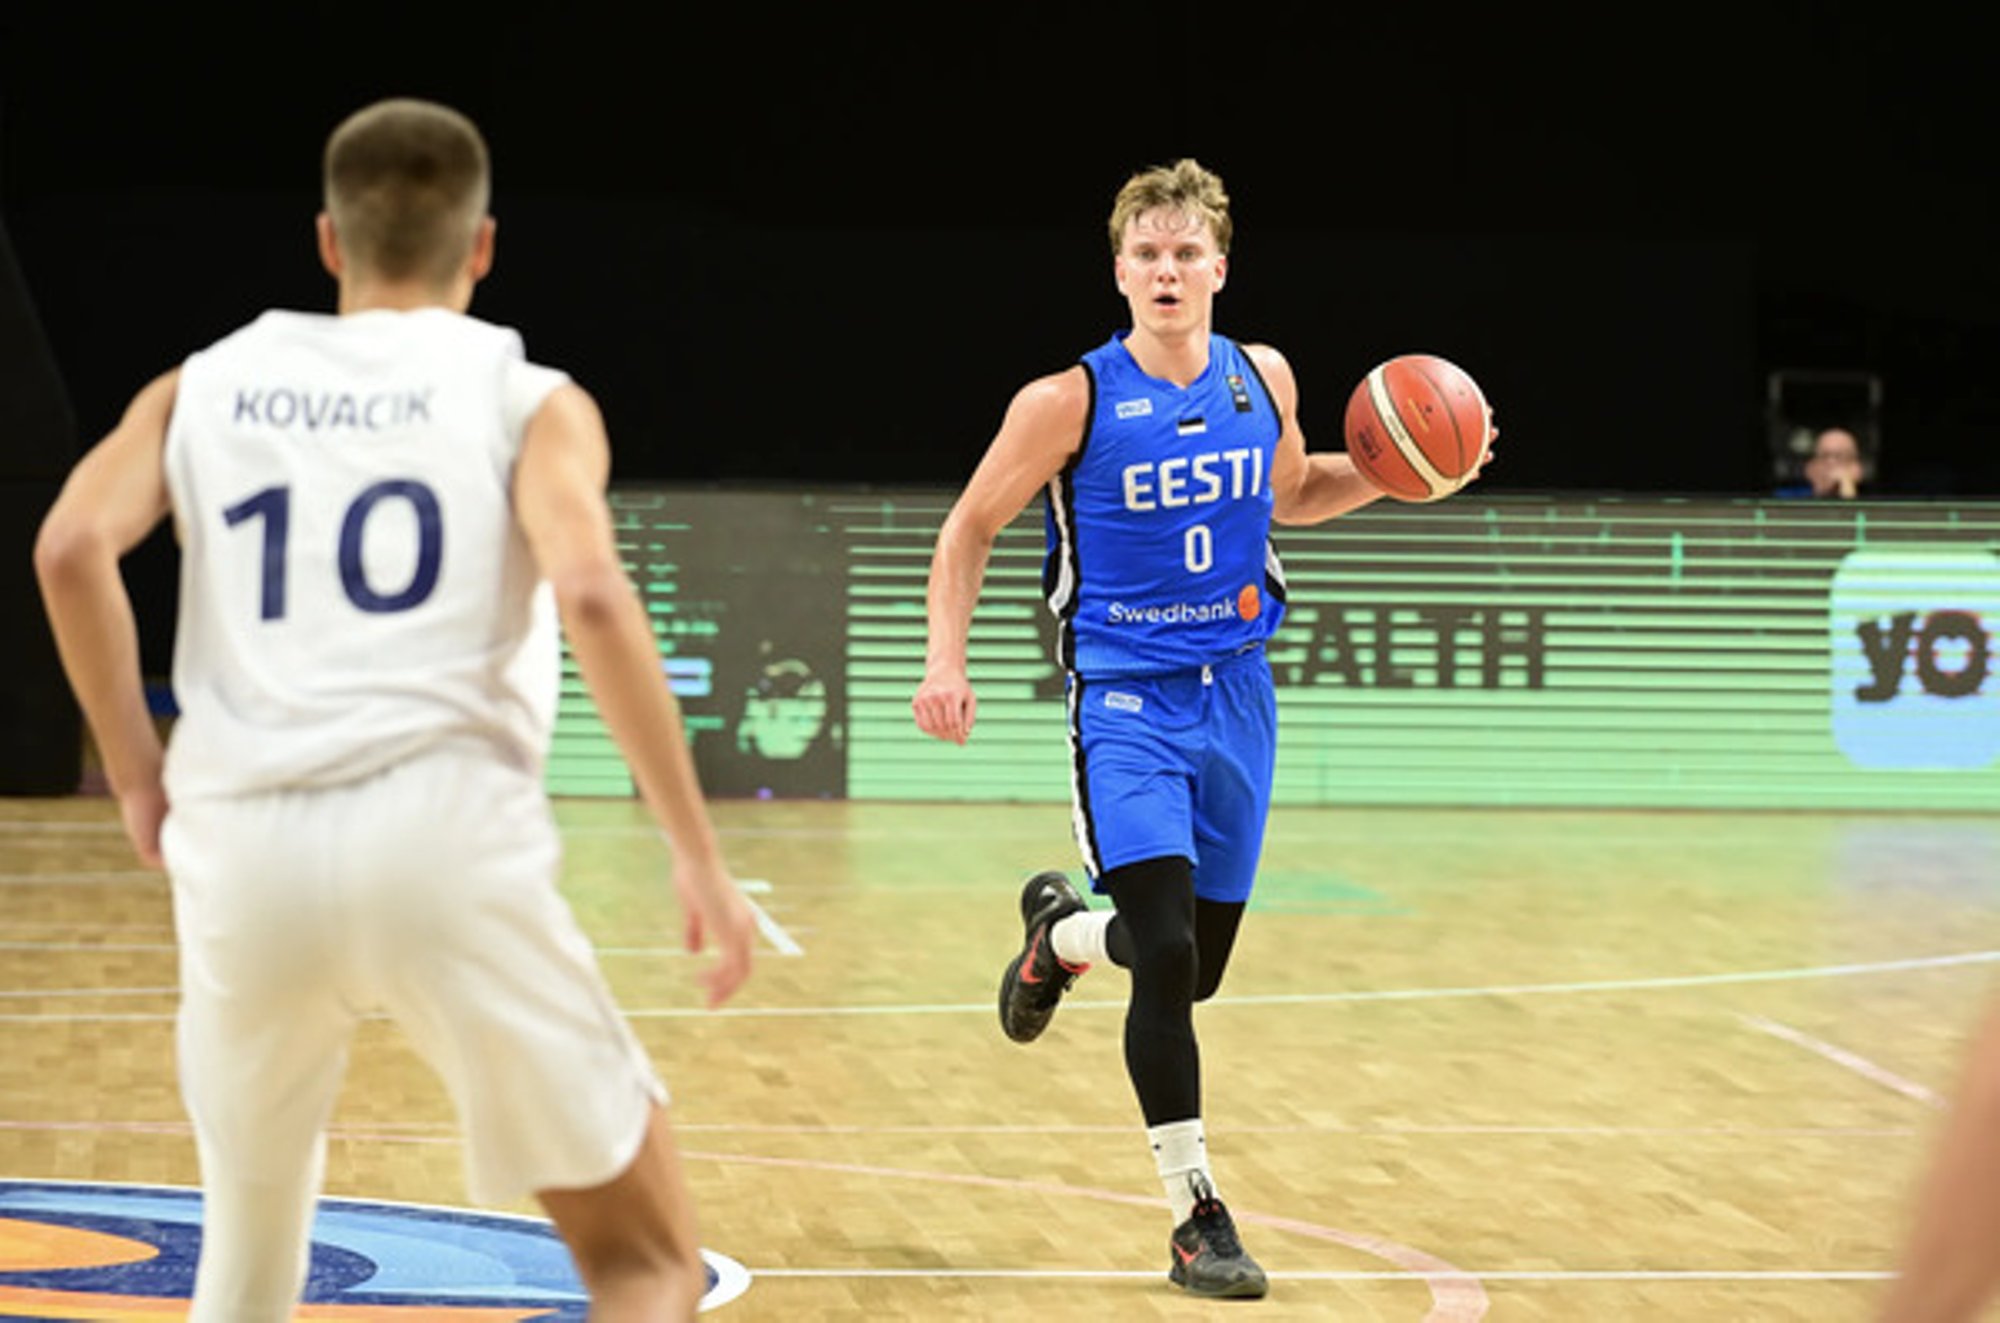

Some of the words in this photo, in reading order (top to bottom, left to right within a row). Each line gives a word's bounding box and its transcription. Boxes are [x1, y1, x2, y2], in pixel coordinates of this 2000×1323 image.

[233, 385, 434, 431] KOVACIK
[1122, 447, 1263, 512] EESTI
[222, 478, 444, 623] 10
[1184, 523, 1213, 573] 0
[1107, 597, 1237, 624] Swedbank
[1854, 608, 1991, 702] yo
